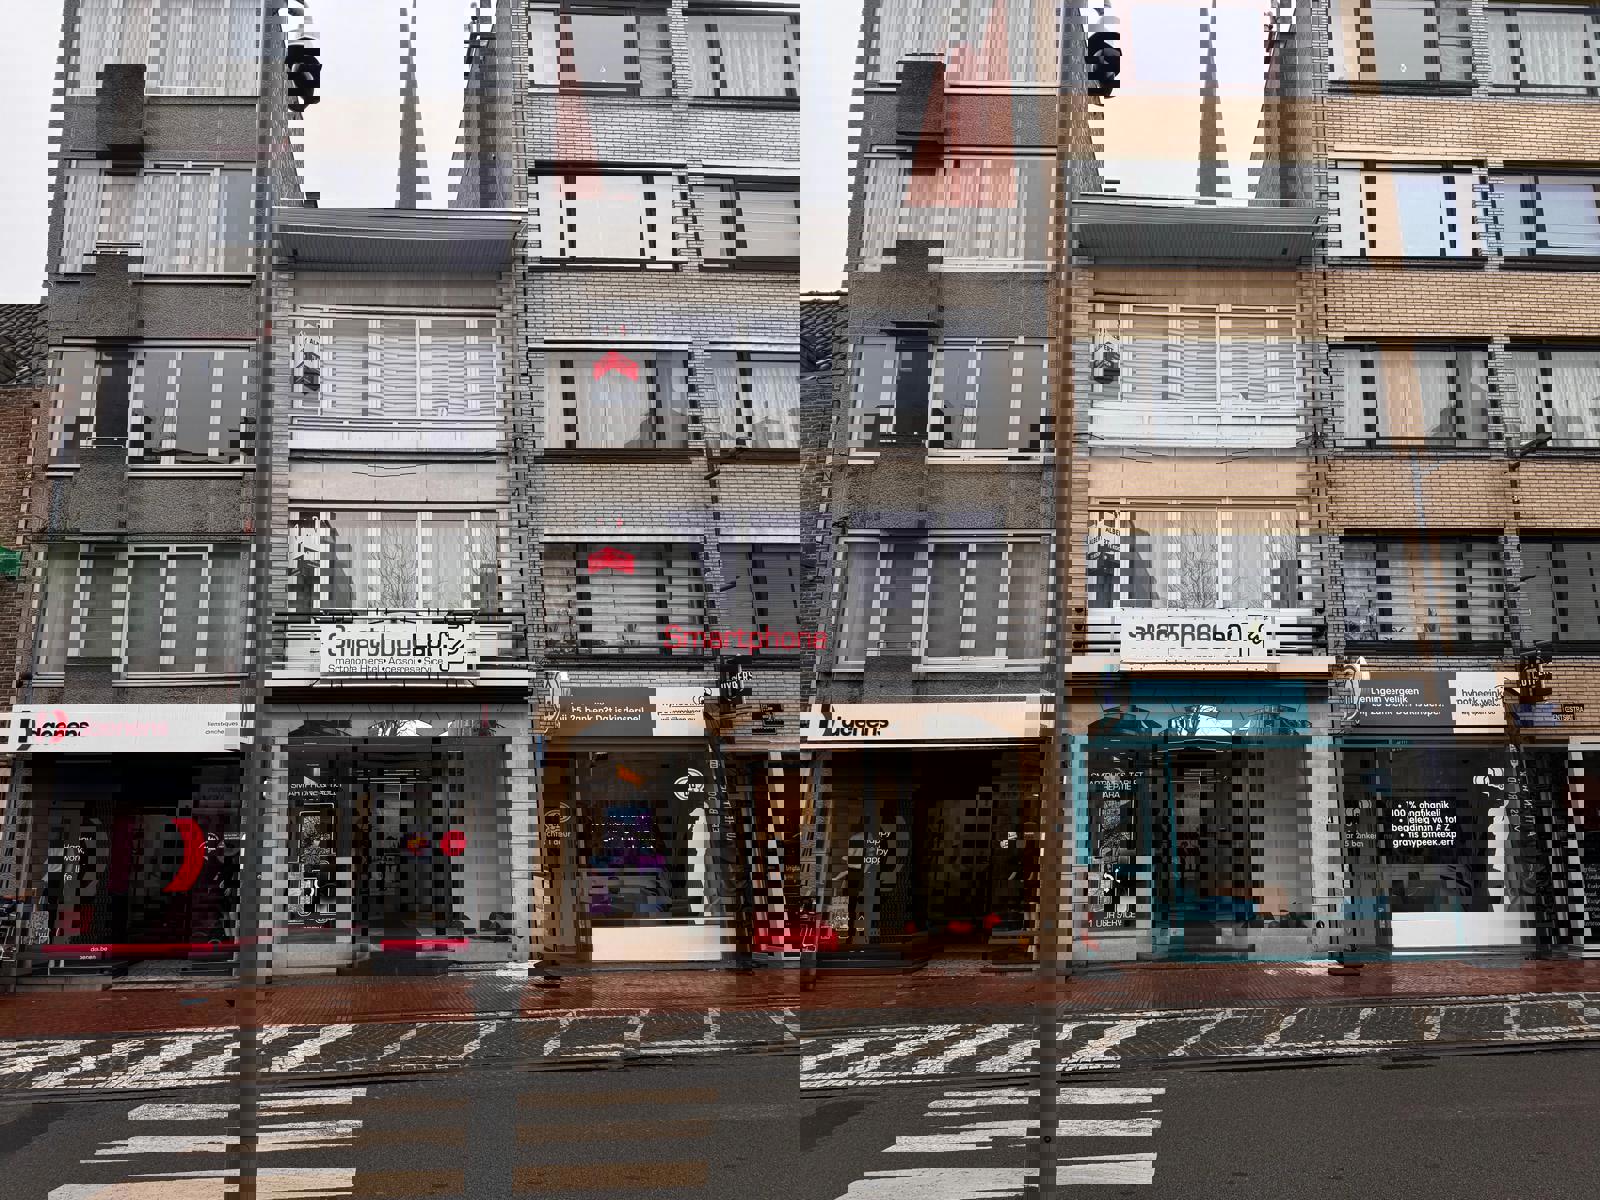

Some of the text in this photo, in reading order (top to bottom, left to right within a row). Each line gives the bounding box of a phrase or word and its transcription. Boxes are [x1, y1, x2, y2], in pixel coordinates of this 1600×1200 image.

[664, 656, 876, 667] Smartphone Herstel Accessoires Service
[1451, 669, 1491, 688] CUYPERS
[73, 716, 170, 737] daenens
[606, 790, 652, 799] REPARATIE
[1197, 808, 1215, 818] 100
[1089, 830, 1106, 838] chts
[1199, 823, 1307, 834] begeleiding van A tot Z
[142, 835, 172, 846] Happy
[1200, 837, 1228, 849] gratis
[140, 854, 169, 866] happy
[138, 864, 153, 874] life
